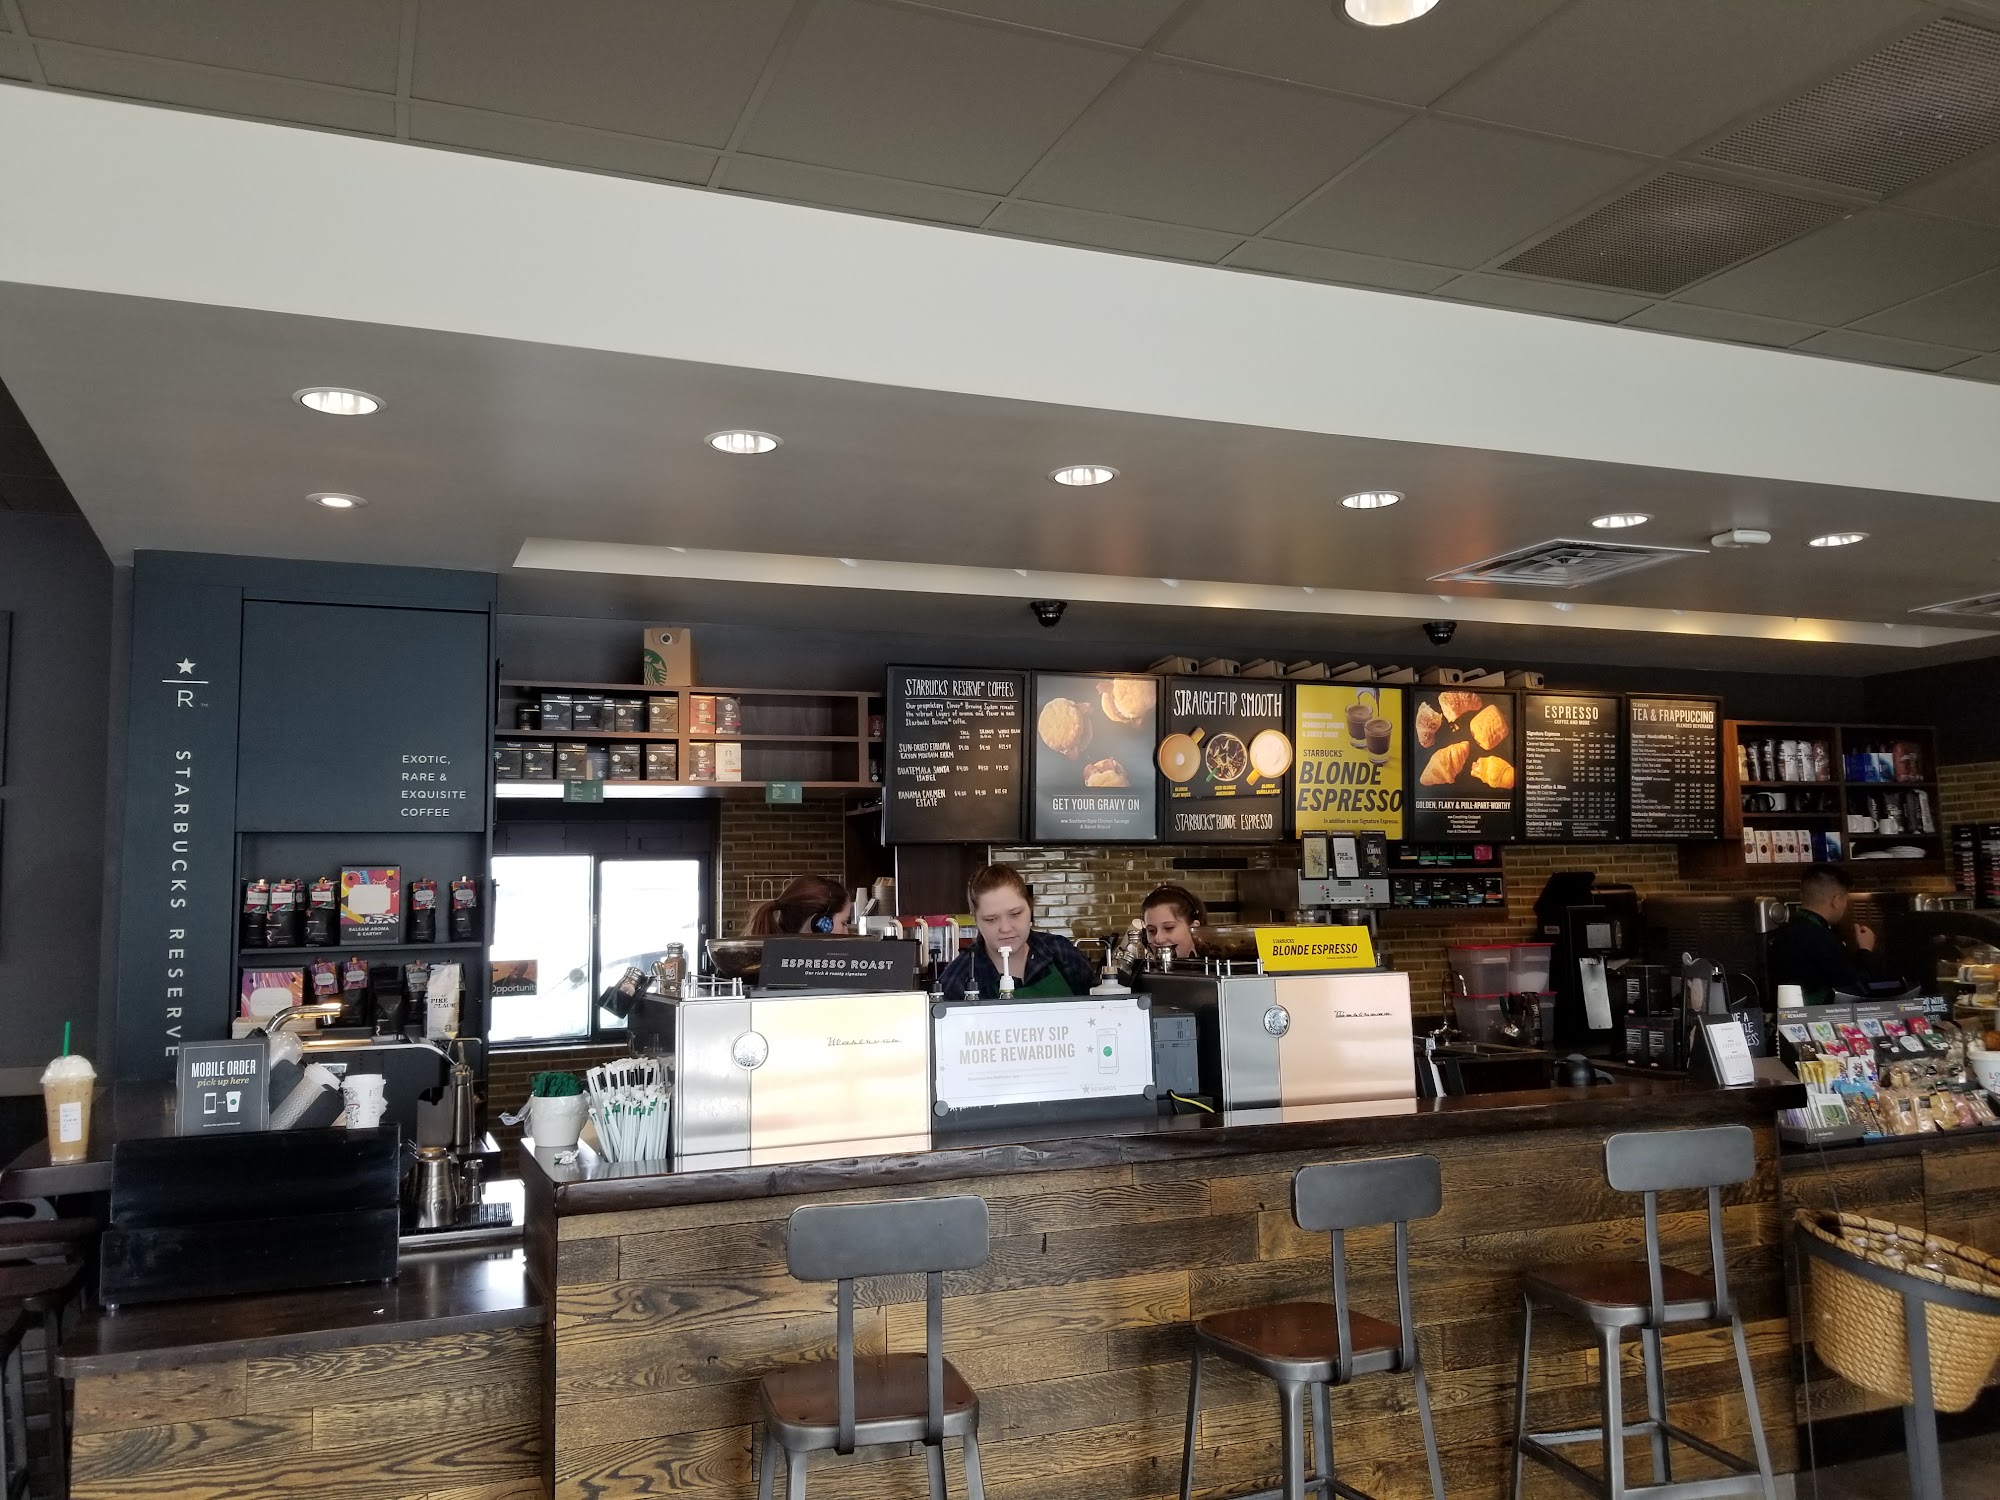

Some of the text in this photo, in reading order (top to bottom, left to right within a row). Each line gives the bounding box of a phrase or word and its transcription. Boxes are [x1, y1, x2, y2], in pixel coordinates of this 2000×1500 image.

[905, 679, 948, 696] STARBUCKS
[988, 682, 1014, 698] COFFEES
[177, 690, 194, 708] R
[1173, 690, 1282, 717] STRAIGHT-UP SMOOTH
[906, 702, 916, 710] Our
[917, 702, 944, 712] proprietary
[1544, 705, 1598, 720] ESPRESSO
[1633, 708, 1648, 720] TEA
[1650, 708, 1658, 722] &
[906, 718, 930, 726] Starbucks
[898, 744, 928, 752] SUN-DRIED
[1304, 749, 1342, 758] STARBUCKS
[402, 754, 450, 766] EXOTIC,
[402, 772, 446, 781] RARE &
[898, 766, 950, 776] GUATEMALA SANTA
[1299, 761, 1384, 785] BLONDE
[401, 790, 466, 799] EXQUISITE
[898, 789, 946, 800] PANAMA CARMEN
[1296, 788, 1403, 812] ESPRESSO
[916, 798, 938, 808] ESTATE
[1052, 798, 1140, 810] GET YOUR GRAVY ON
[1416, 800, 1438, 810] GOLDEN,
[1438, 801, 1454, 809] FLAKY
[1460, 802, 1511, 810] PULL-APART-WORTHY
[400, 808, 450, 816] COFFEE
[1175, 814, 1272, 831] STARBUCKS BLONDE ESPRESSO
[165, 751, 192, 1056] STARBUCKS RESERVE
[1272, 944, 1358, 956] BLONDE ESPRESSO
[781, 958, 894, 970] ESPRESSO ROAST
[964, 1026, 1069, 1046] MAKE EVERY SIP
[960, 1044, 1076, 1065] MORE REWARDING
[191, 1060, 256, 1078] MOBILE ORDER
[196, 1076, 250, 1088] pick up here
